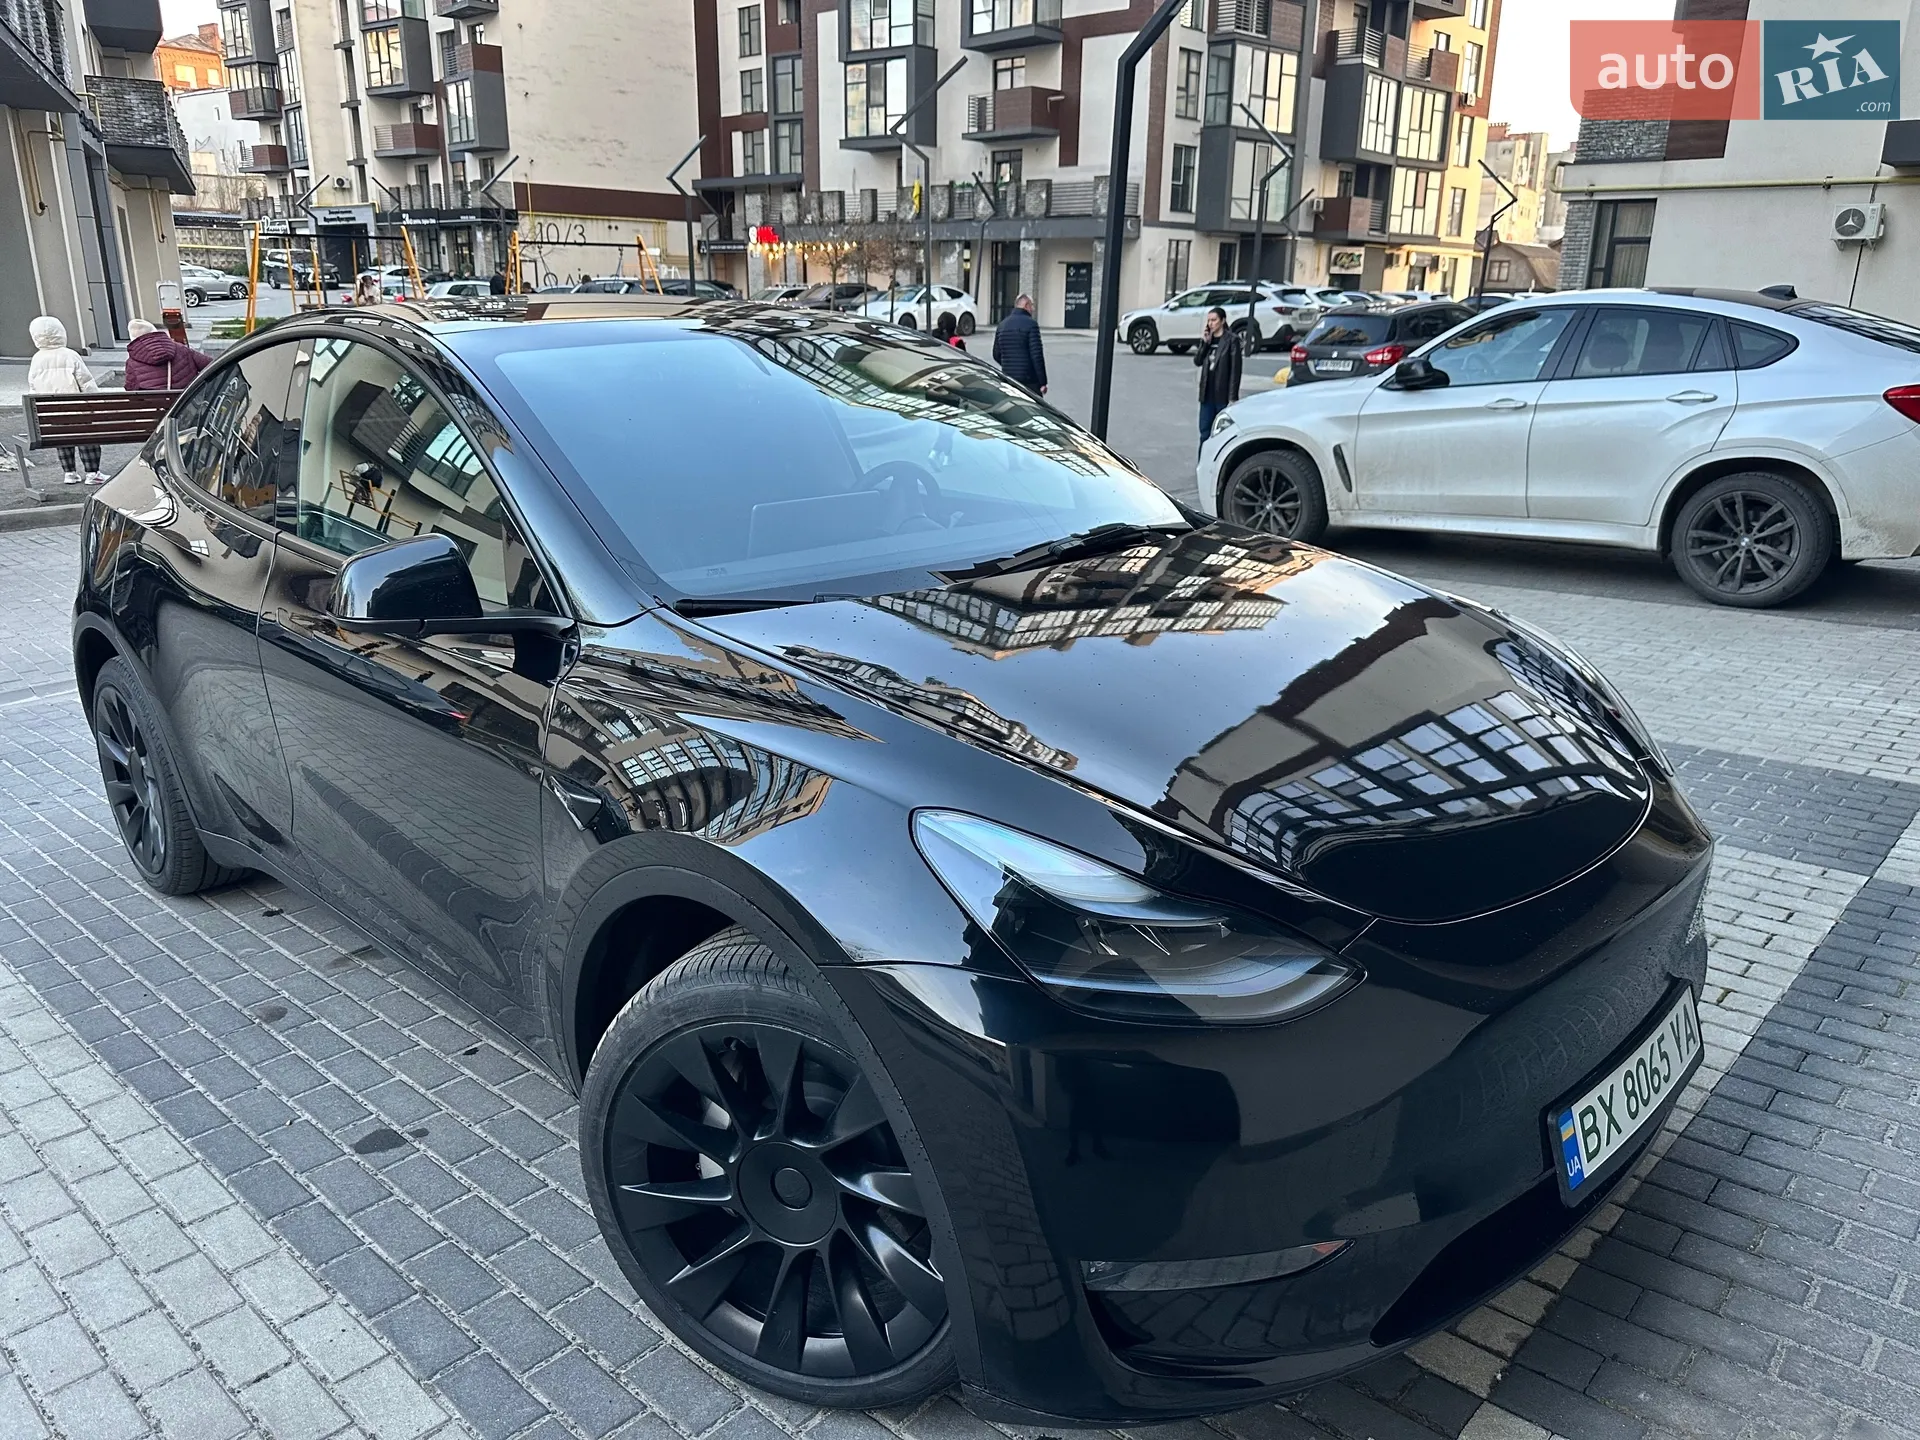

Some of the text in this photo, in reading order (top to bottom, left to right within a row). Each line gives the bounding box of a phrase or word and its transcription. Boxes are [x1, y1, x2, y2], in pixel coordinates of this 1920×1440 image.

[537, 222, 587, 247] 10/3
[1578, 1003, 1697, 1164] BX 8065 YA
[1566, 1156, 1582, 1177] UA
